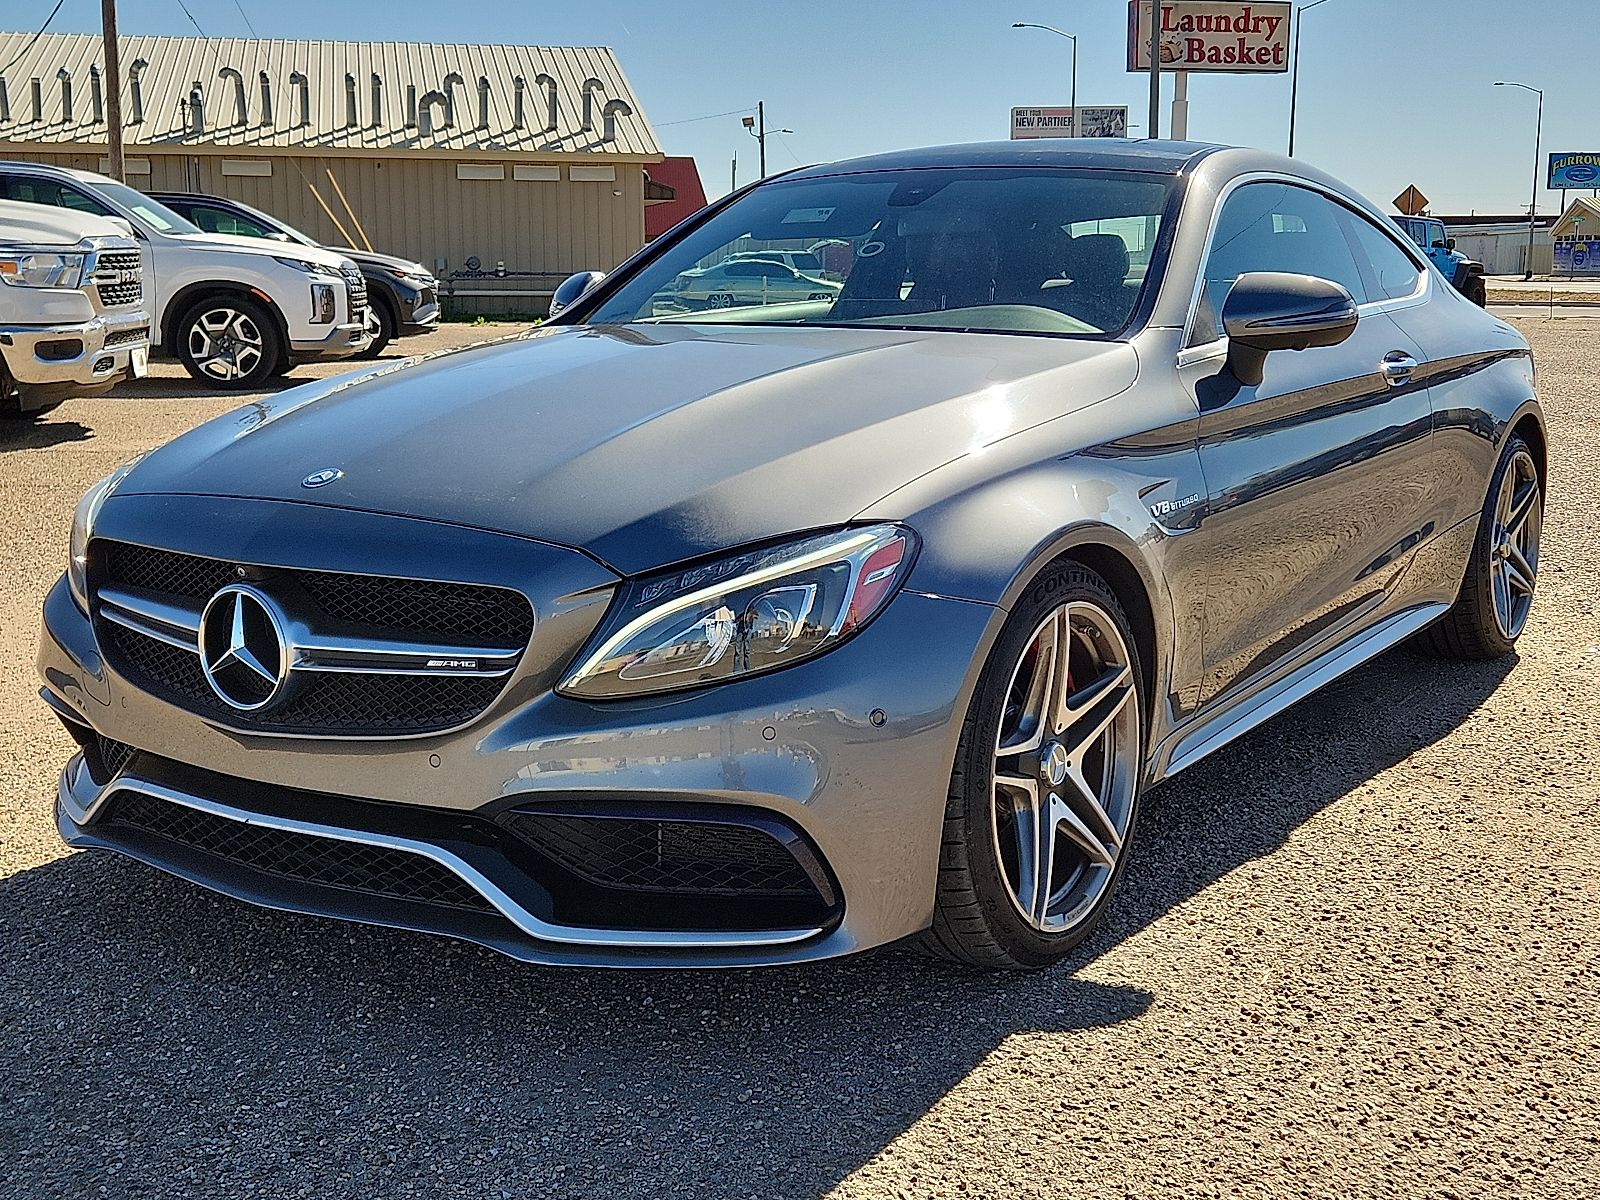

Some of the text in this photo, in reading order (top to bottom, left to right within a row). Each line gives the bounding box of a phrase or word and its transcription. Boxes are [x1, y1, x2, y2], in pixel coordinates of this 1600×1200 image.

[1161, 6, 1282, 41] Laundry
[1184, 38, 1284, 64] Basket
[1015, 109, 1028, 117] MEET
[1015, 116, 1036, 128] NEW
[1150, 494, 1198, 516] V8 BITURBO
